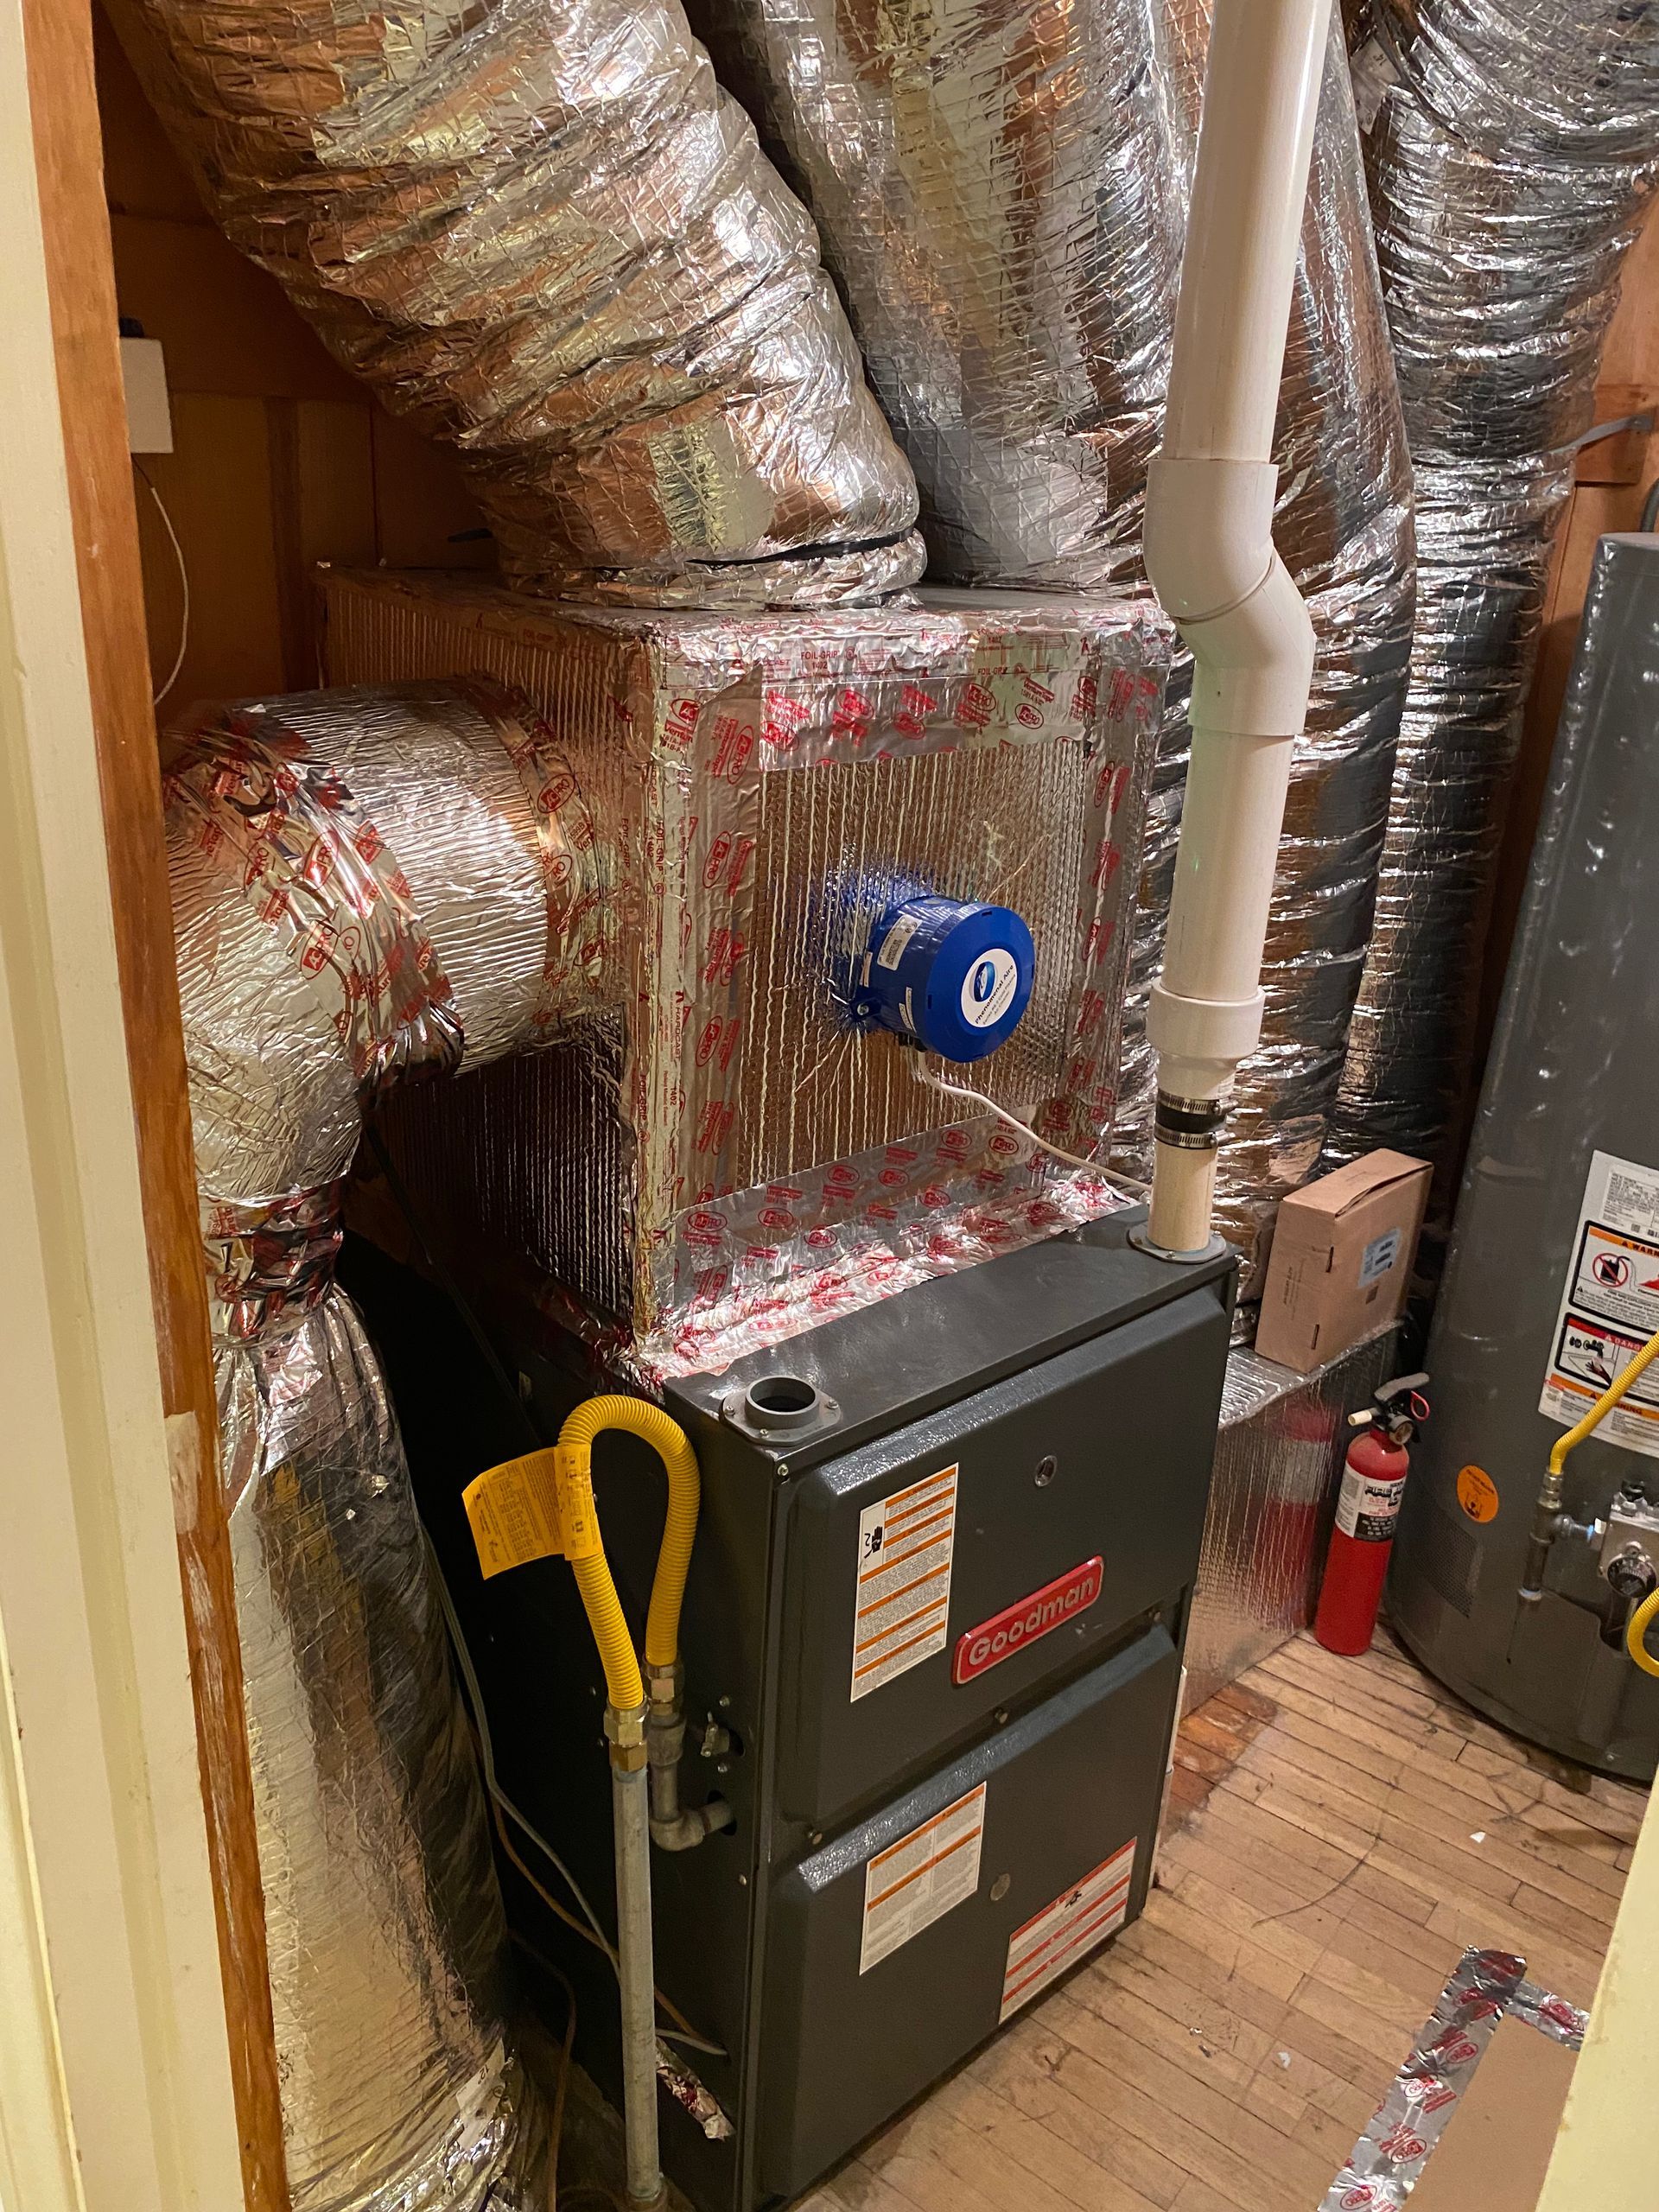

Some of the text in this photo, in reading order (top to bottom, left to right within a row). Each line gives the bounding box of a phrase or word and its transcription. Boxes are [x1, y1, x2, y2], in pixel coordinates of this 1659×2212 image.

[800, 650, 839, 660] FOIL-GRIP
[541, 779, 570, 810] AC PRO
[621, 817, 630, 868] FOIL-GRIP
[707, 840, 729, 880] AC PRO
[302, 925, 334, 971] AC PRO
[976, 981, 1003, 1024] Phenomenal
[1003, 964, 1014, 981] Aire
[1614, 1337, 1643, 1351] DANG
[969, 1576, 1095, 1666] Goodman
